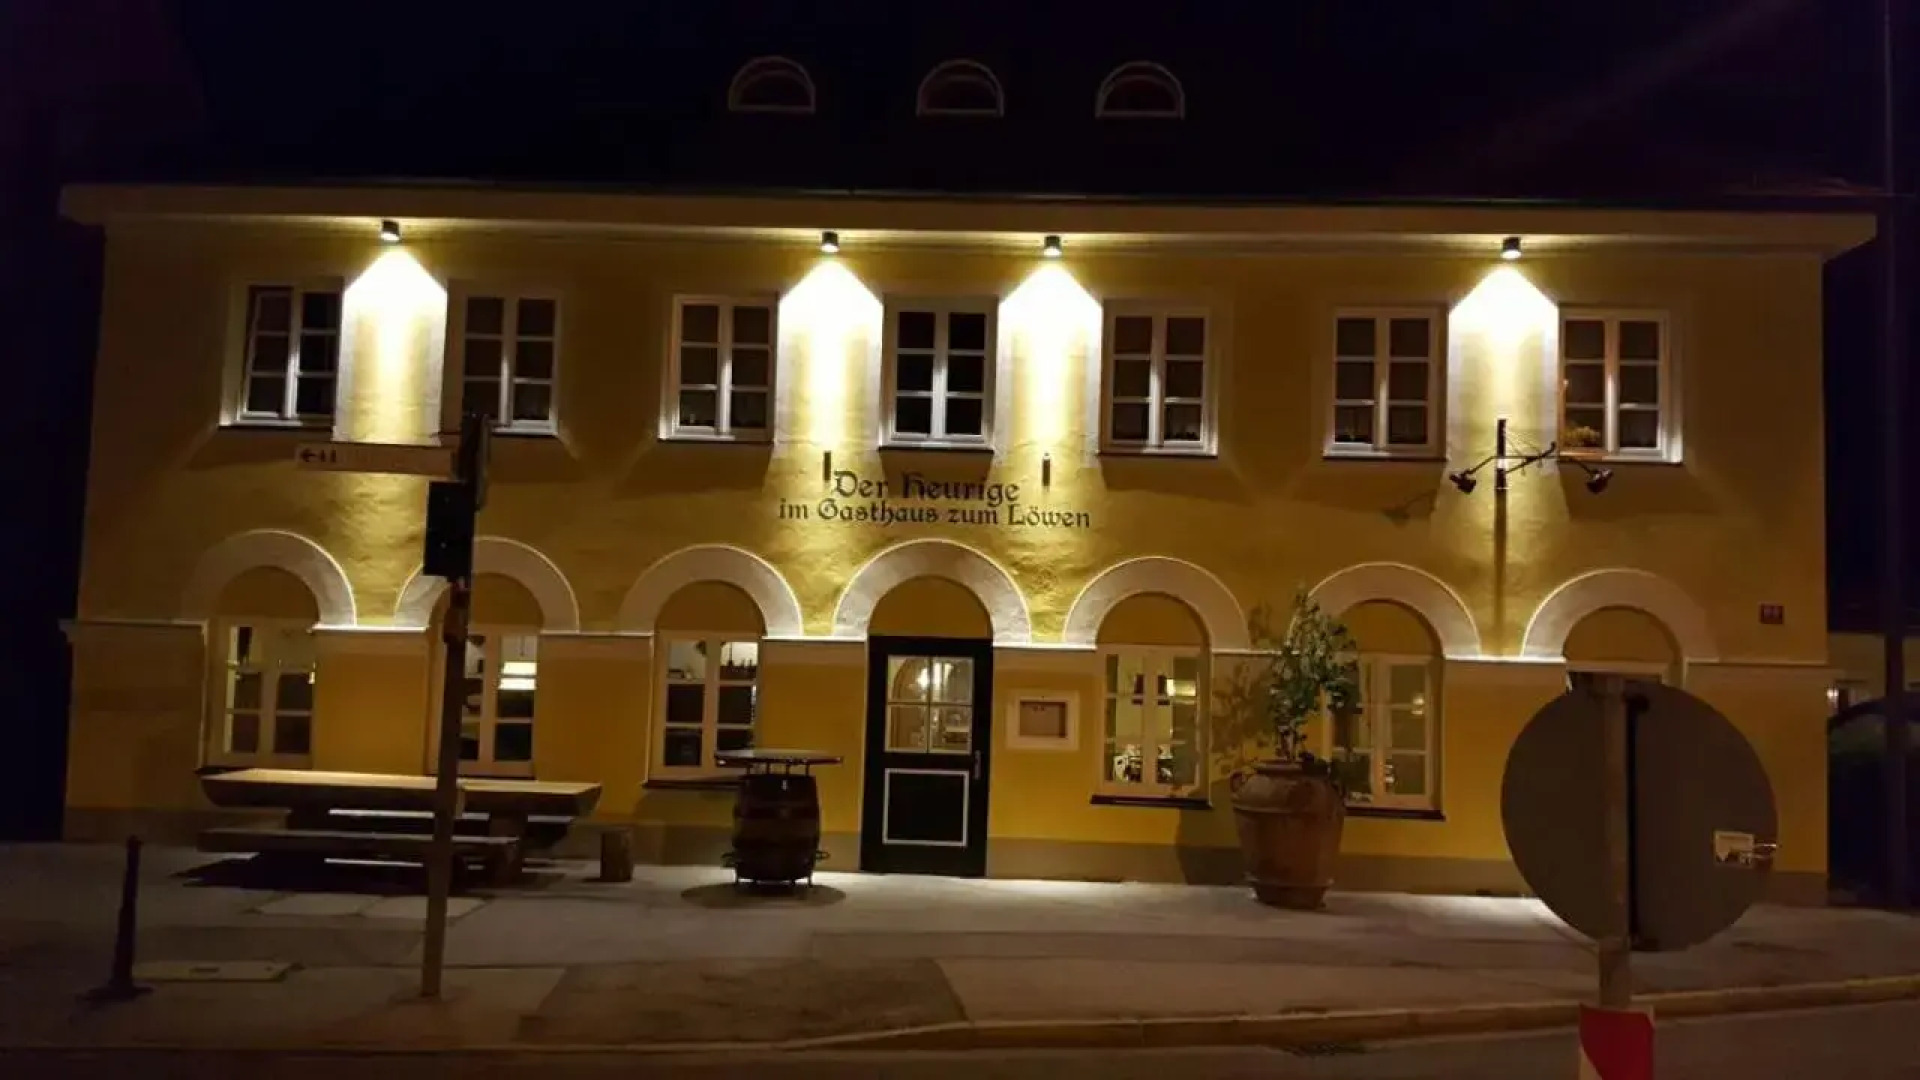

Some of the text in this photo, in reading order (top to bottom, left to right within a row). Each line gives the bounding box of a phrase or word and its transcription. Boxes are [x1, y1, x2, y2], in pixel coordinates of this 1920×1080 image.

[834, 471, 1019, 506] Der Heurige
[779, 498, 1090, 528] im Gasthaus zum Löwen
